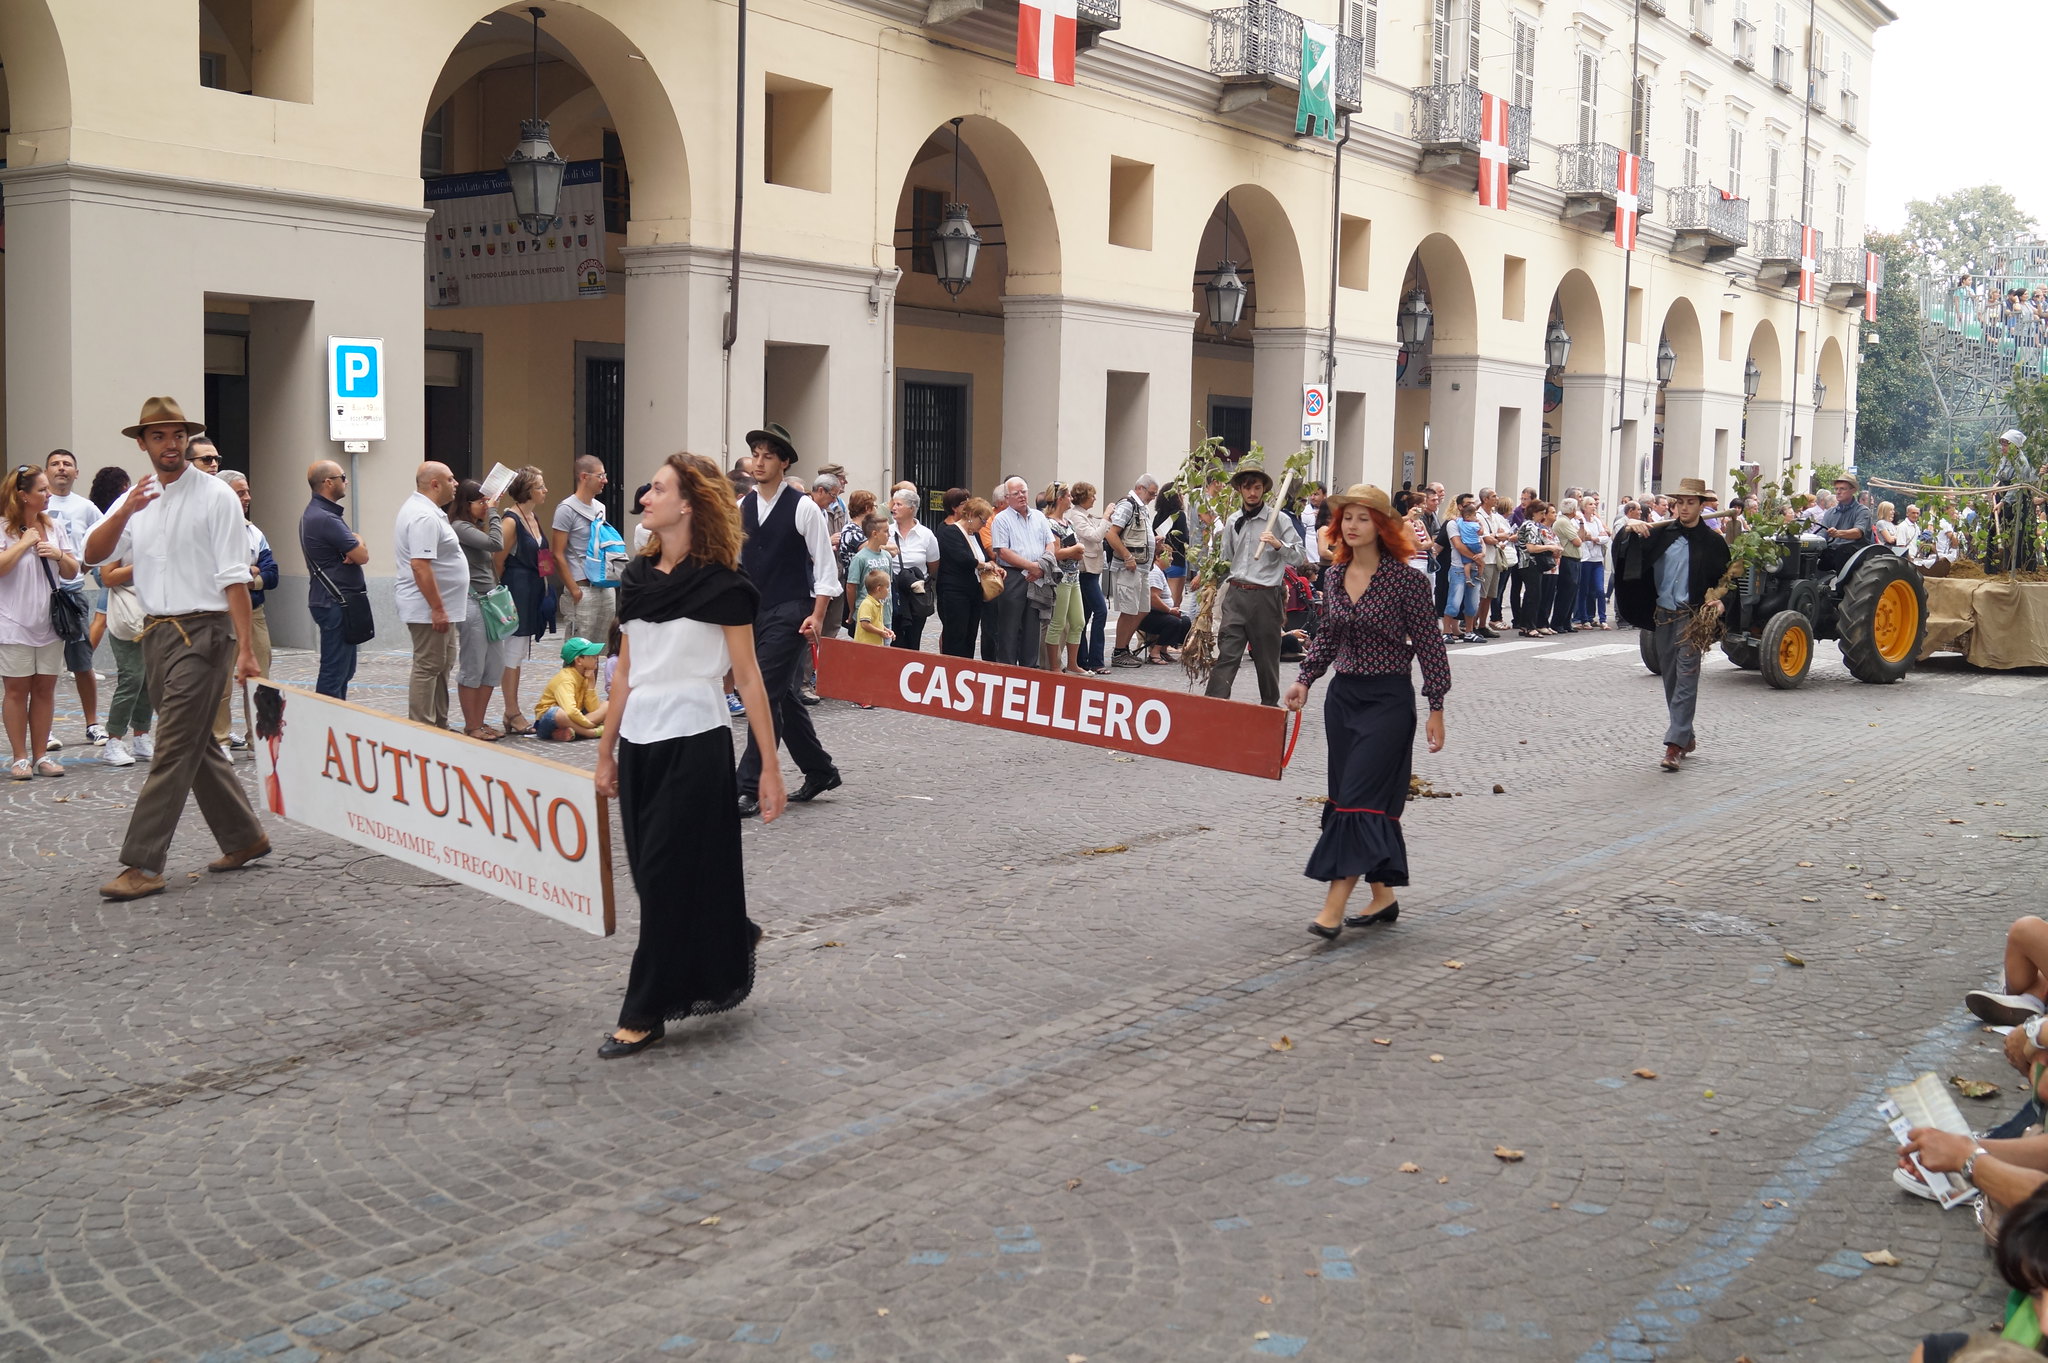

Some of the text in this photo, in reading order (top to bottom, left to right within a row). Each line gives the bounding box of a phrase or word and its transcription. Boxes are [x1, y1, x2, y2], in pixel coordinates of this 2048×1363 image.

[498, 269, 518, 278] LEGAME
[519, 268, 530, 276] CON
[536, 266, 565, 274] TERRITORIO
[344, 352, 370, 391] P
[900, 661, 1171, 745] CASTELLERO
[321, 726, 588, 863] AUTUNNO
[347, 811, 593, 916] VENDEMMIE, STREGONI E SANTI
